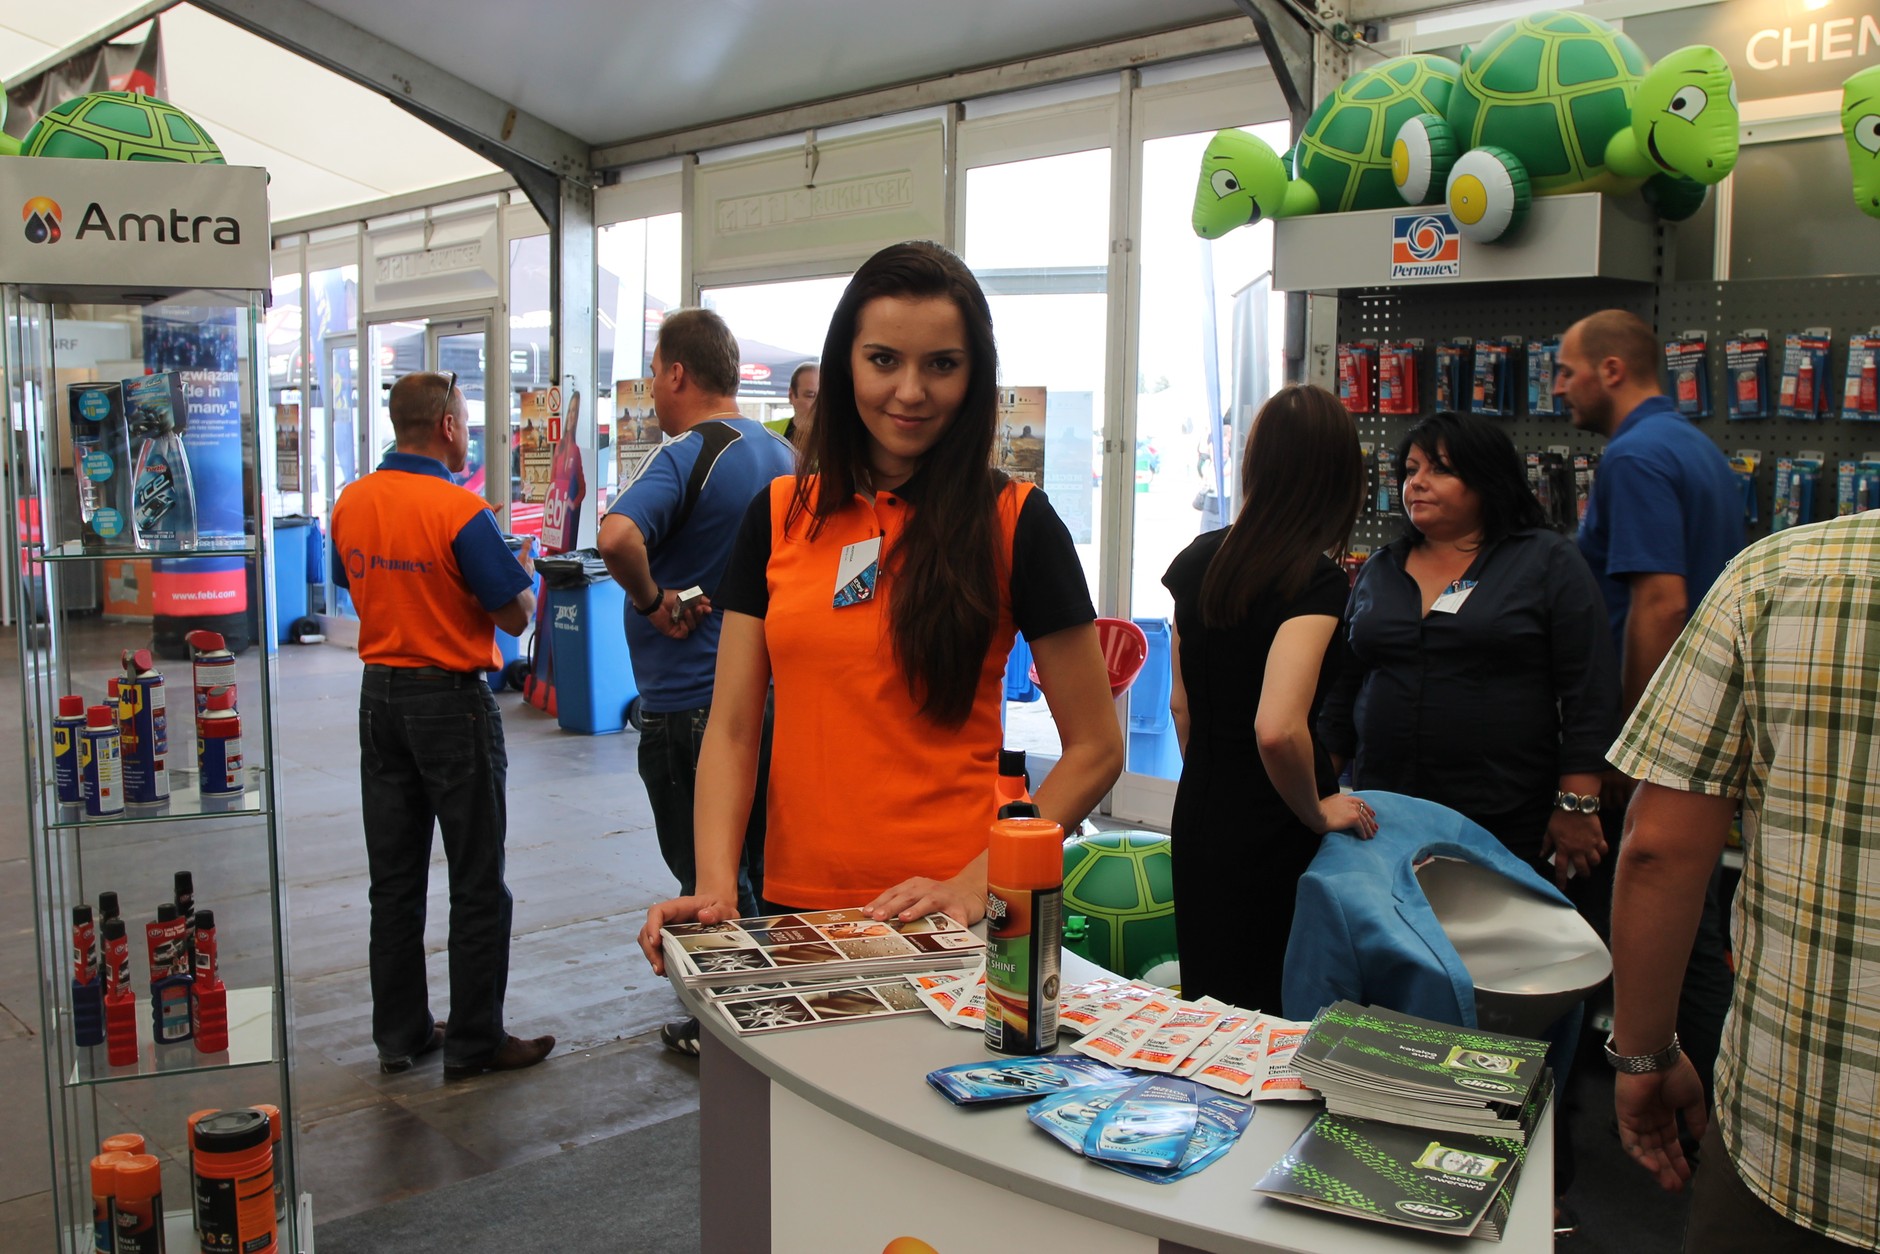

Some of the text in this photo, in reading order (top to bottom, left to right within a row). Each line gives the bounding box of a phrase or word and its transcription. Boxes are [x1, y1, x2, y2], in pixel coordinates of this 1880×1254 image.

[75, 202, 240, 245] Amtra
[1393, 264, 1453, 277] Permatex
[371, 555, 428, 573] Permatex
[172, 589, 236, 600] www.febi.com
[991, 959, 1016, 973] SHINE
[1400, 1045, 1438, 1057] katalog
[1411, 1052, 1436, 1060] auto
[1461, 1078, 1510, 1092] slime
[1425, 1174, 1485, 1191] rowerowy
[1442, 1173, 1487, 1187] katalog
[1402, 1202, 1457, 1218] slime
